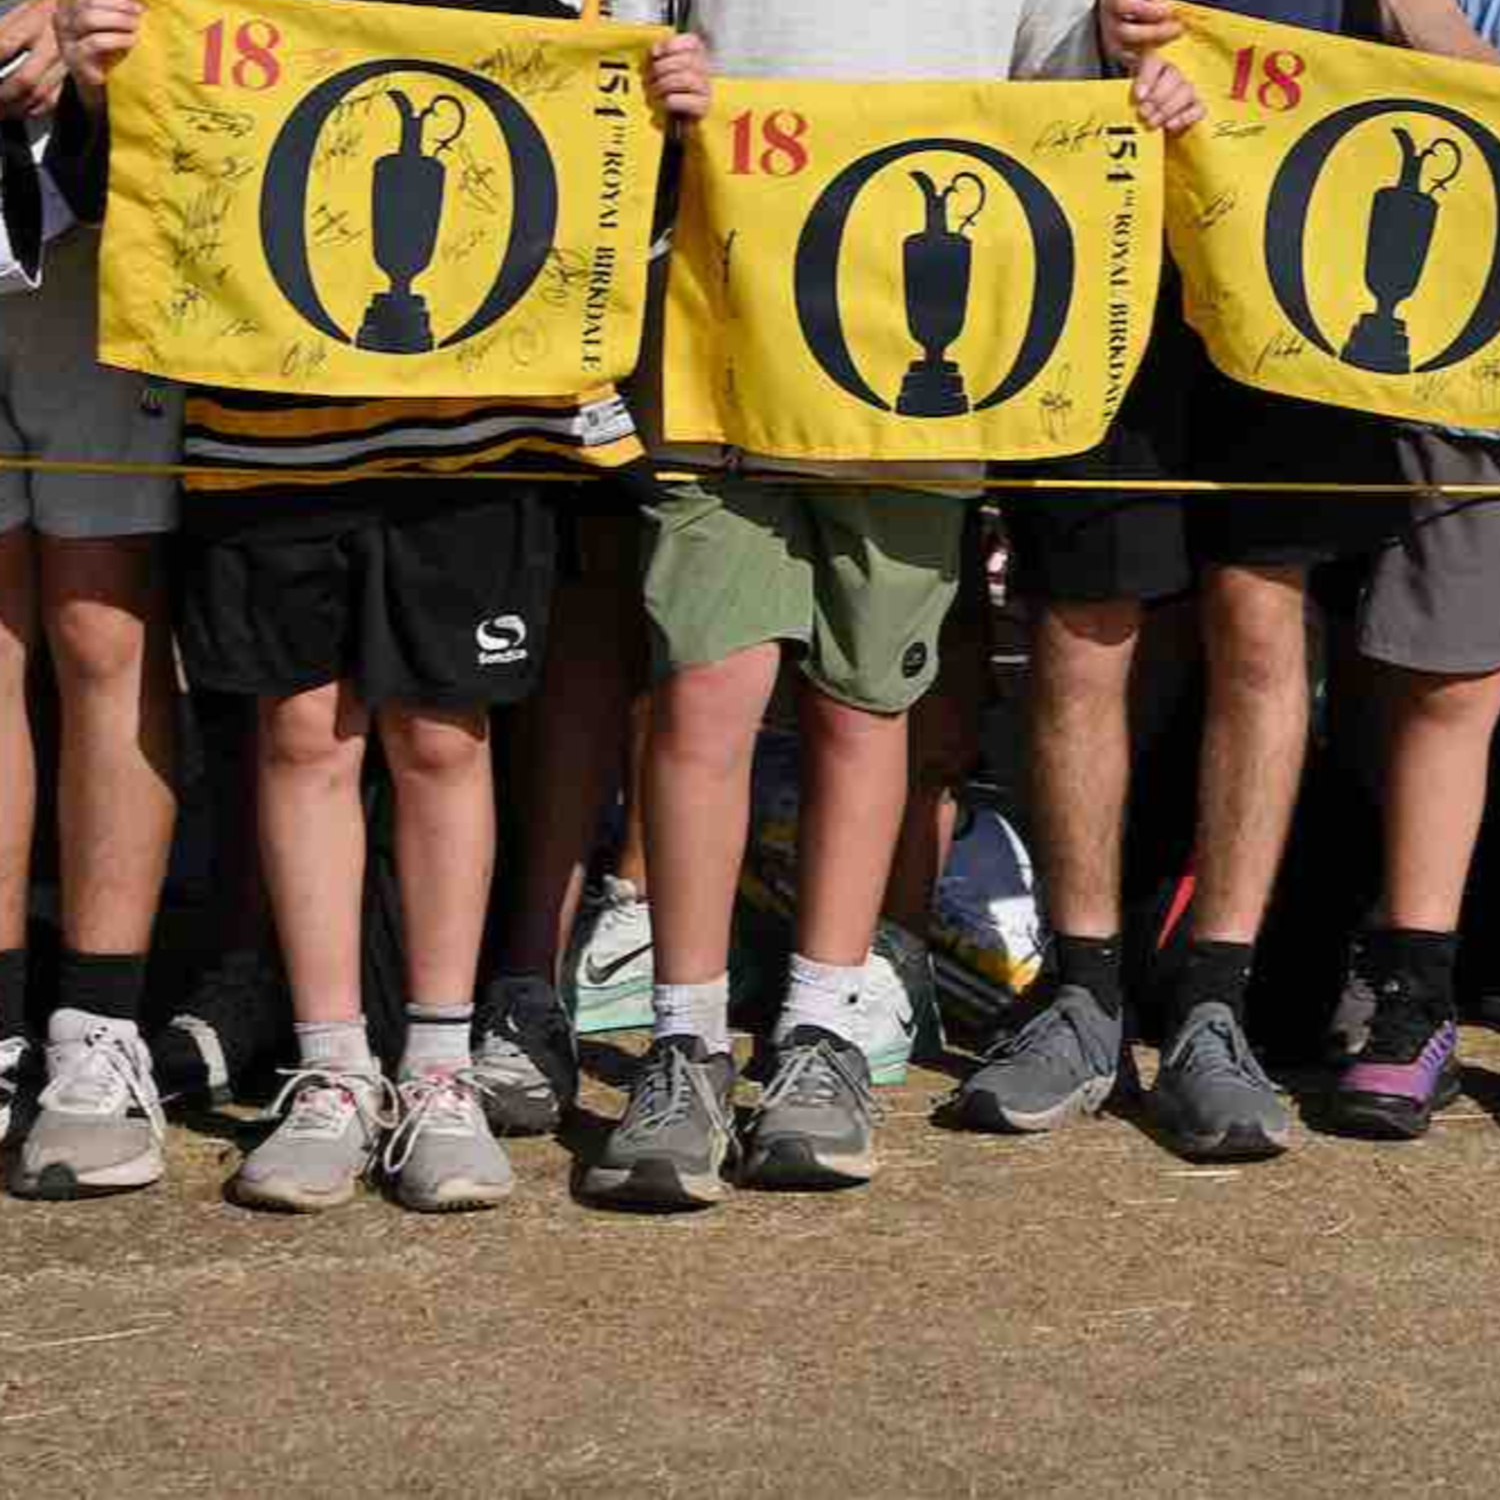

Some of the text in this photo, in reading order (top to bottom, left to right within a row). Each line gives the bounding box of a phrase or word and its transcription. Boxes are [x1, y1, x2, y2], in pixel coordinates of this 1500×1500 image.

[196, 18, 281, 91] 18
[1226, 44, 1307, 112] 18
[726, 108, 809, 177] 18
[598, 151, 625, 232] ROYAL
[1108, 213, 1133, 291] ROYAL
[580, 246, 616, 374] BIRKDALE
